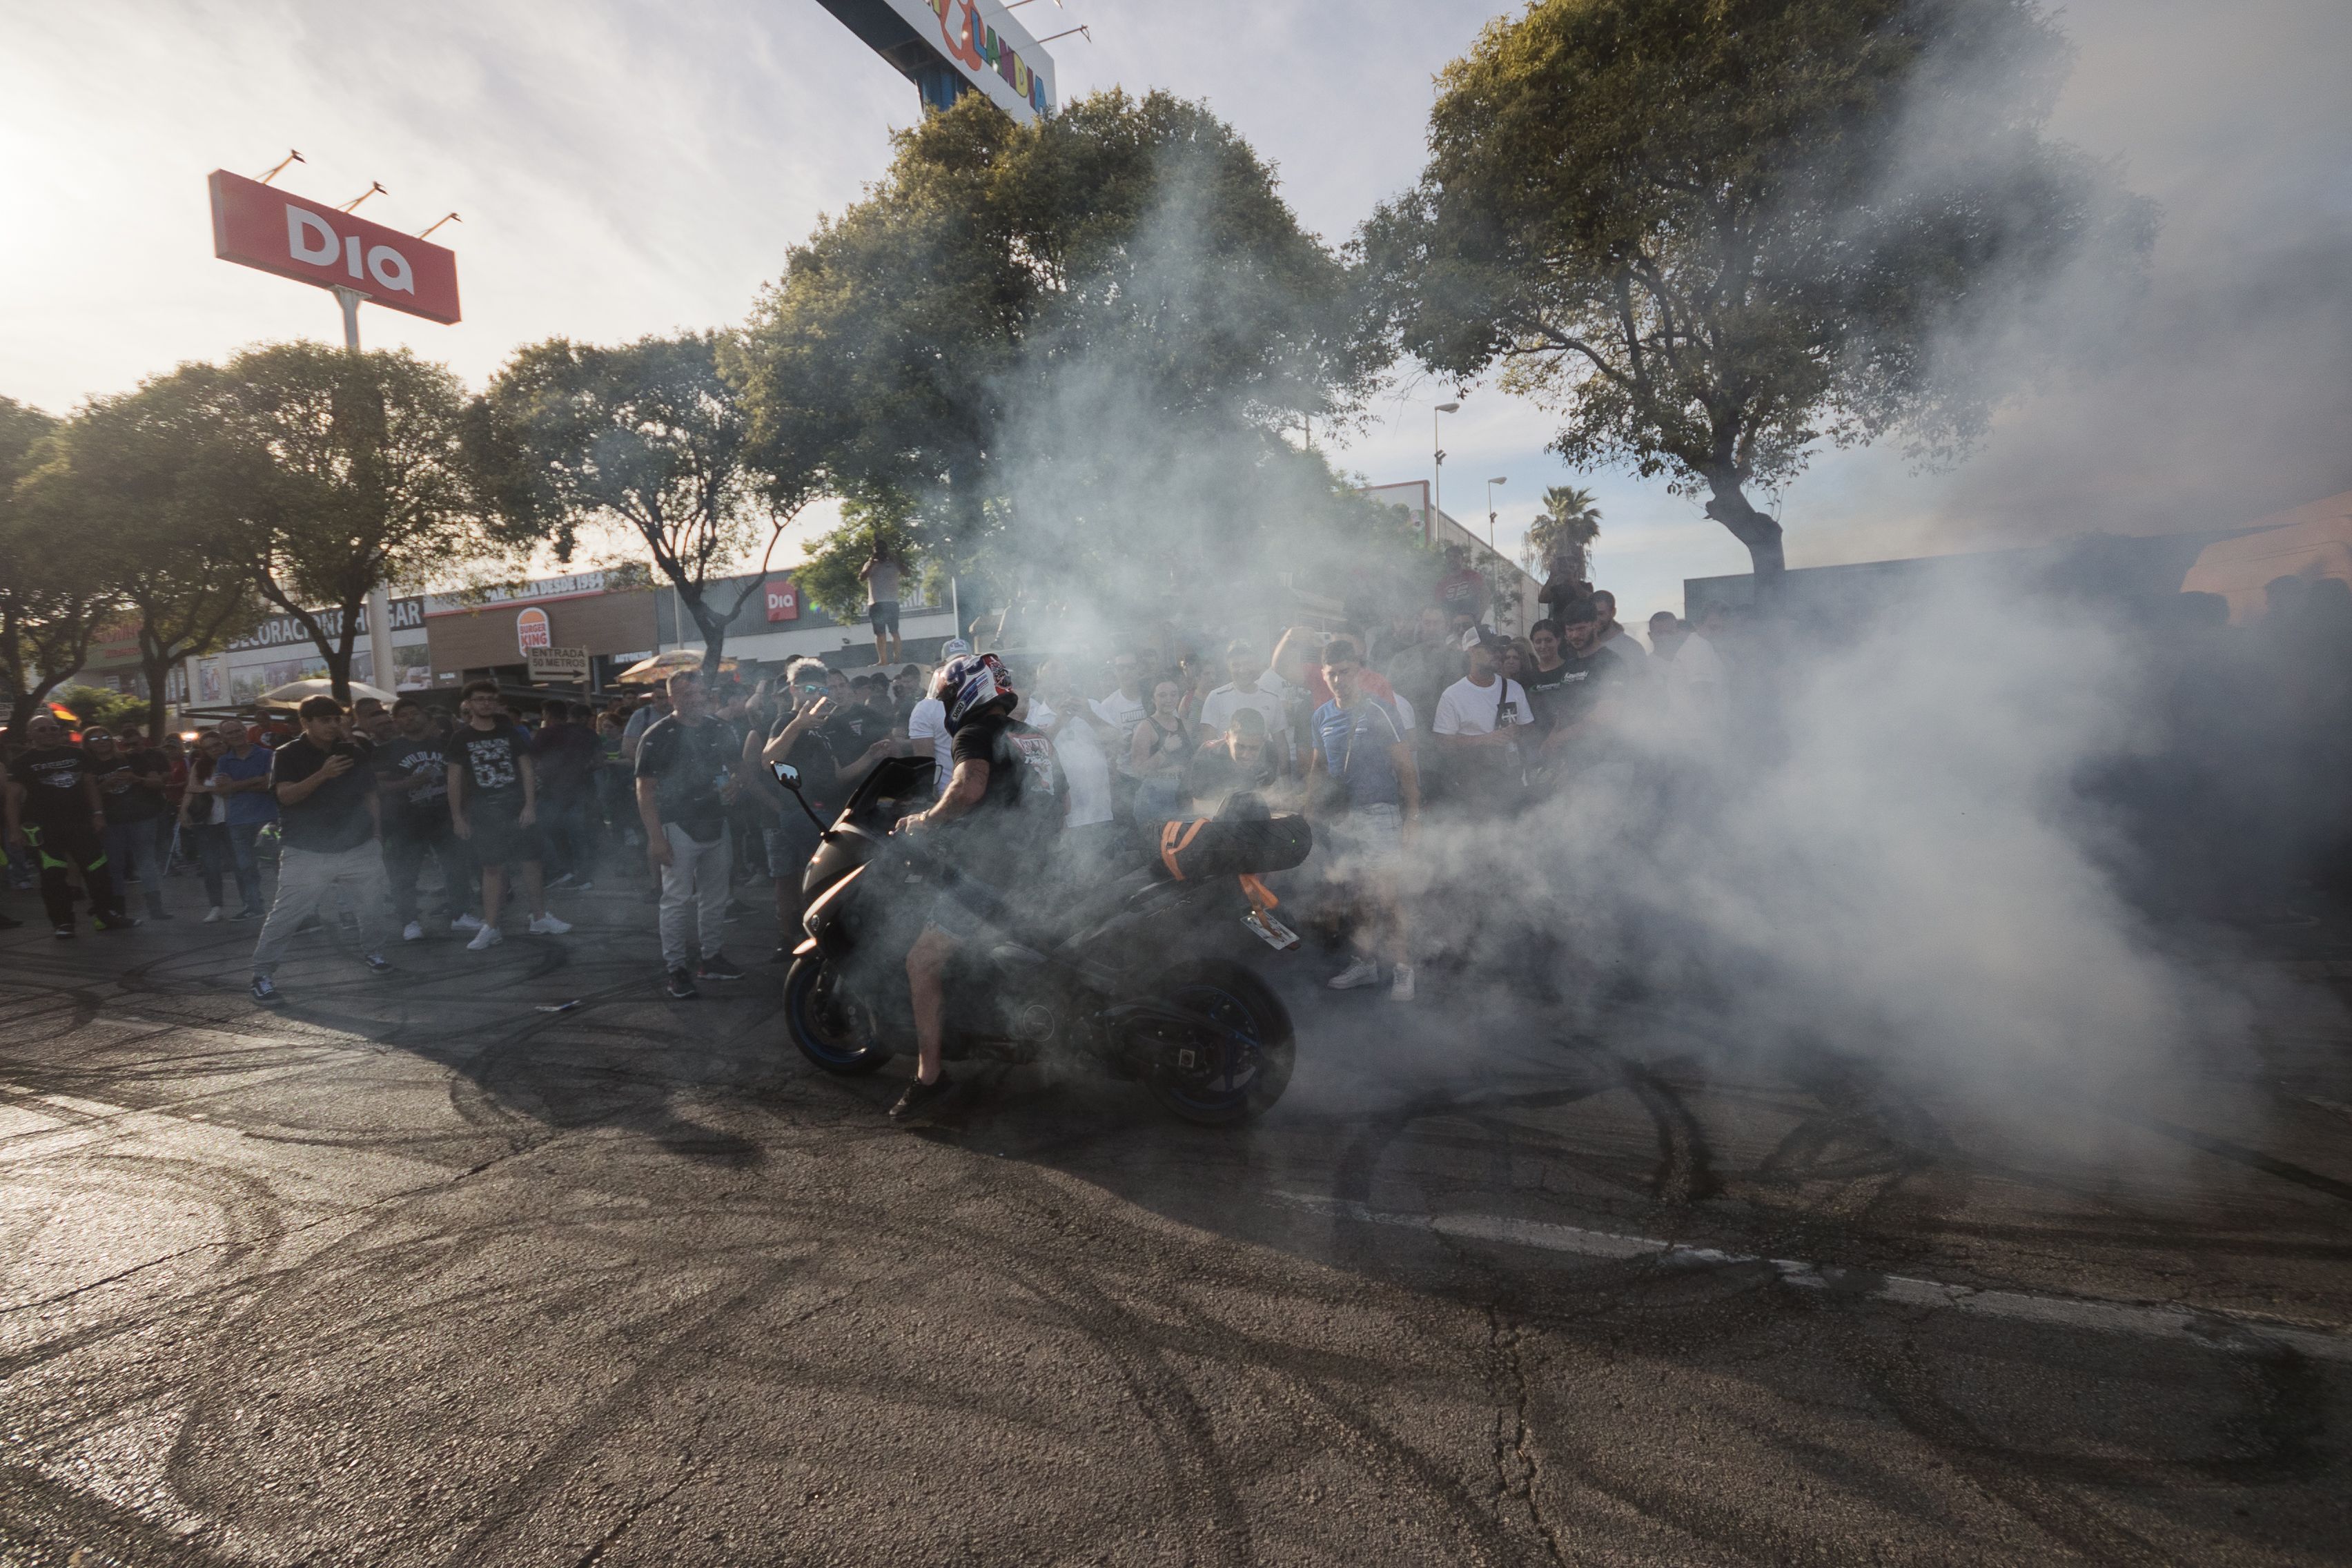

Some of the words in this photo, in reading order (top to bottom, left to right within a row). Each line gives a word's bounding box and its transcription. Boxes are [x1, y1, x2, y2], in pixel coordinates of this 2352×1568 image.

[540, 579, 575, 594] DESDE
[576, 572, 605, 589] 1954
[355, 601, 421, 632] HGAR
[520, 623, 546, 634] BURGER
[520, 632, 547, 646] KING
[532, 648, 585, 658] ENTRADA
[532, 658, 543, 667] 50
[545, 658, 586, 667] METROS
[952, 700, 964, 719] SHOEI
